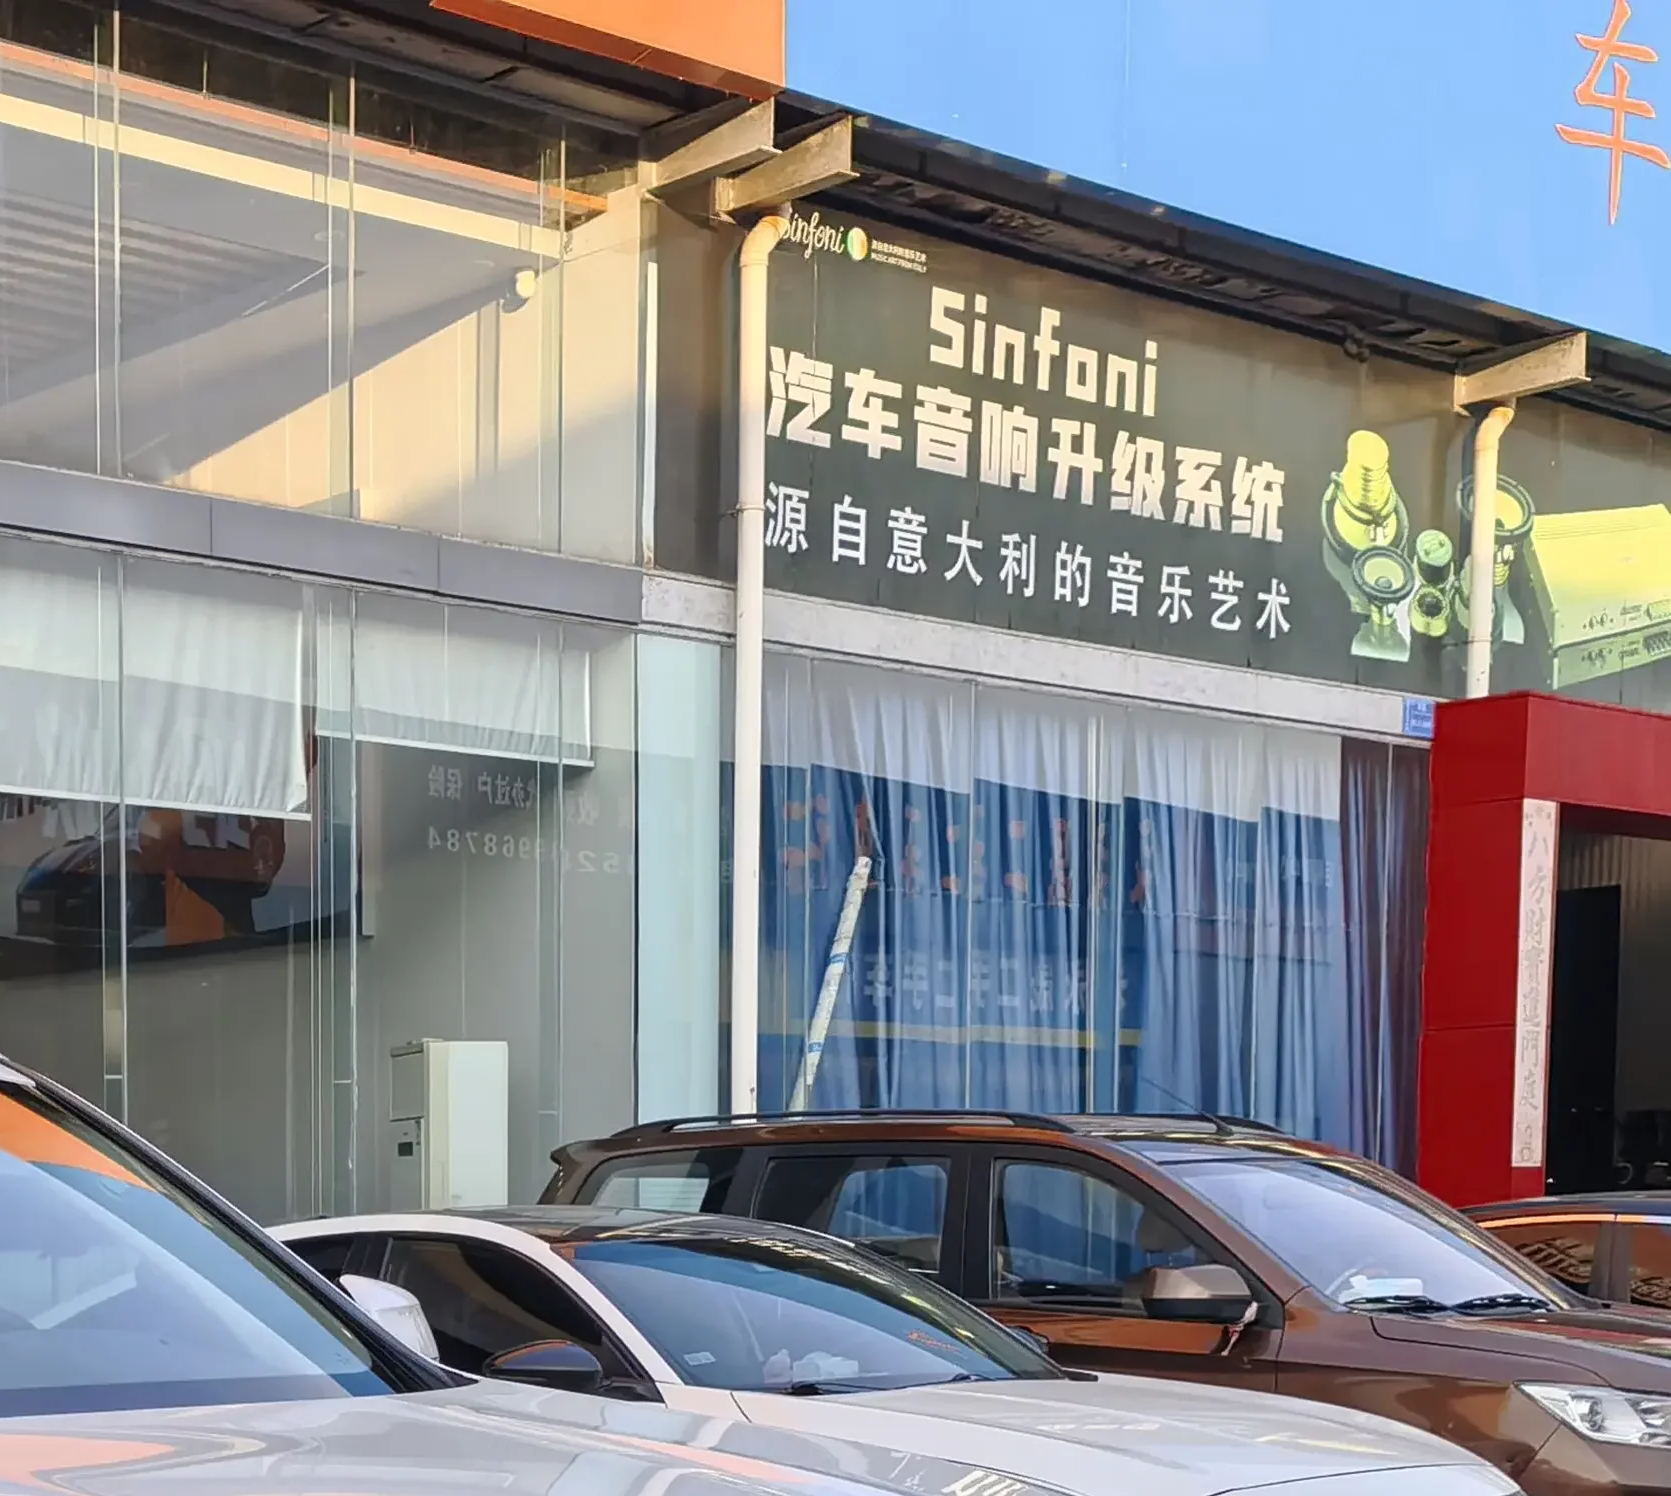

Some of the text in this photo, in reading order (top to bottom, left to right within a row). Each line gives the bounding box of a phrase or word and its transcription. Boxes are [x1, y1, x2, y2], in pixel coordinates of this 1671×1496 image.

[1554, 0, 1671, 225] 车
[929, 286, 1158, 417] Sinfoni
[765, 345, 1285, 543] 汽车音响升级系统
[764, 481, 1291, 640] 源自意大利的音乐艺术
